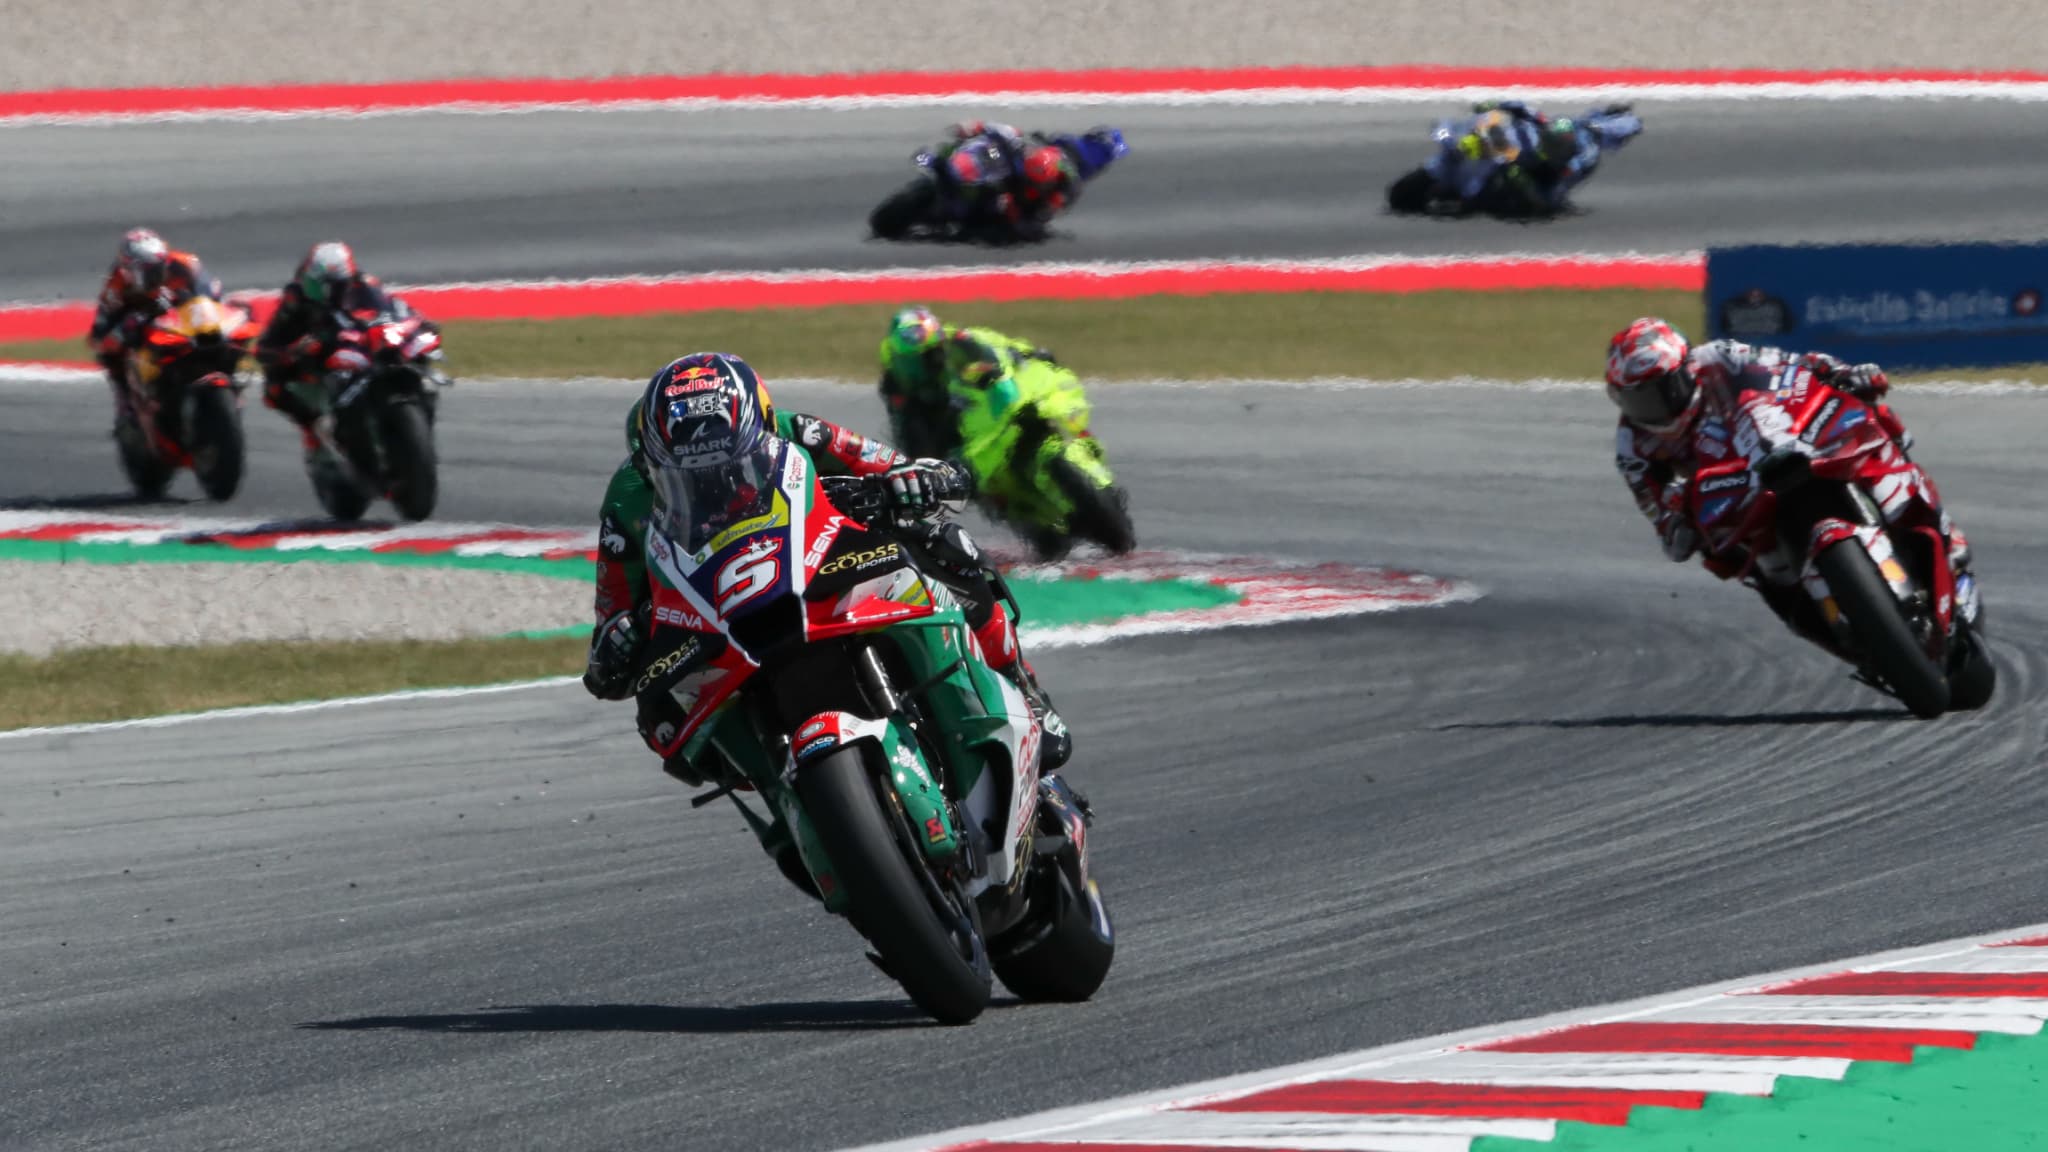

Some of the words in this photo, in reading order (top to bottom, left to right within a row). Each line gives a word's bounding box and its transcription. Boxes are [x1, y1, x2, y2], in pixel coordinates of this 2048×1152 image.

[665, 380, 694, 397] Red
[673, 436, 733, 456] SHARK
[804, 515, 845, 569] SENA
[856, 553, 900, 571] SPORTS
[655, 606, 703, 631] SENA
